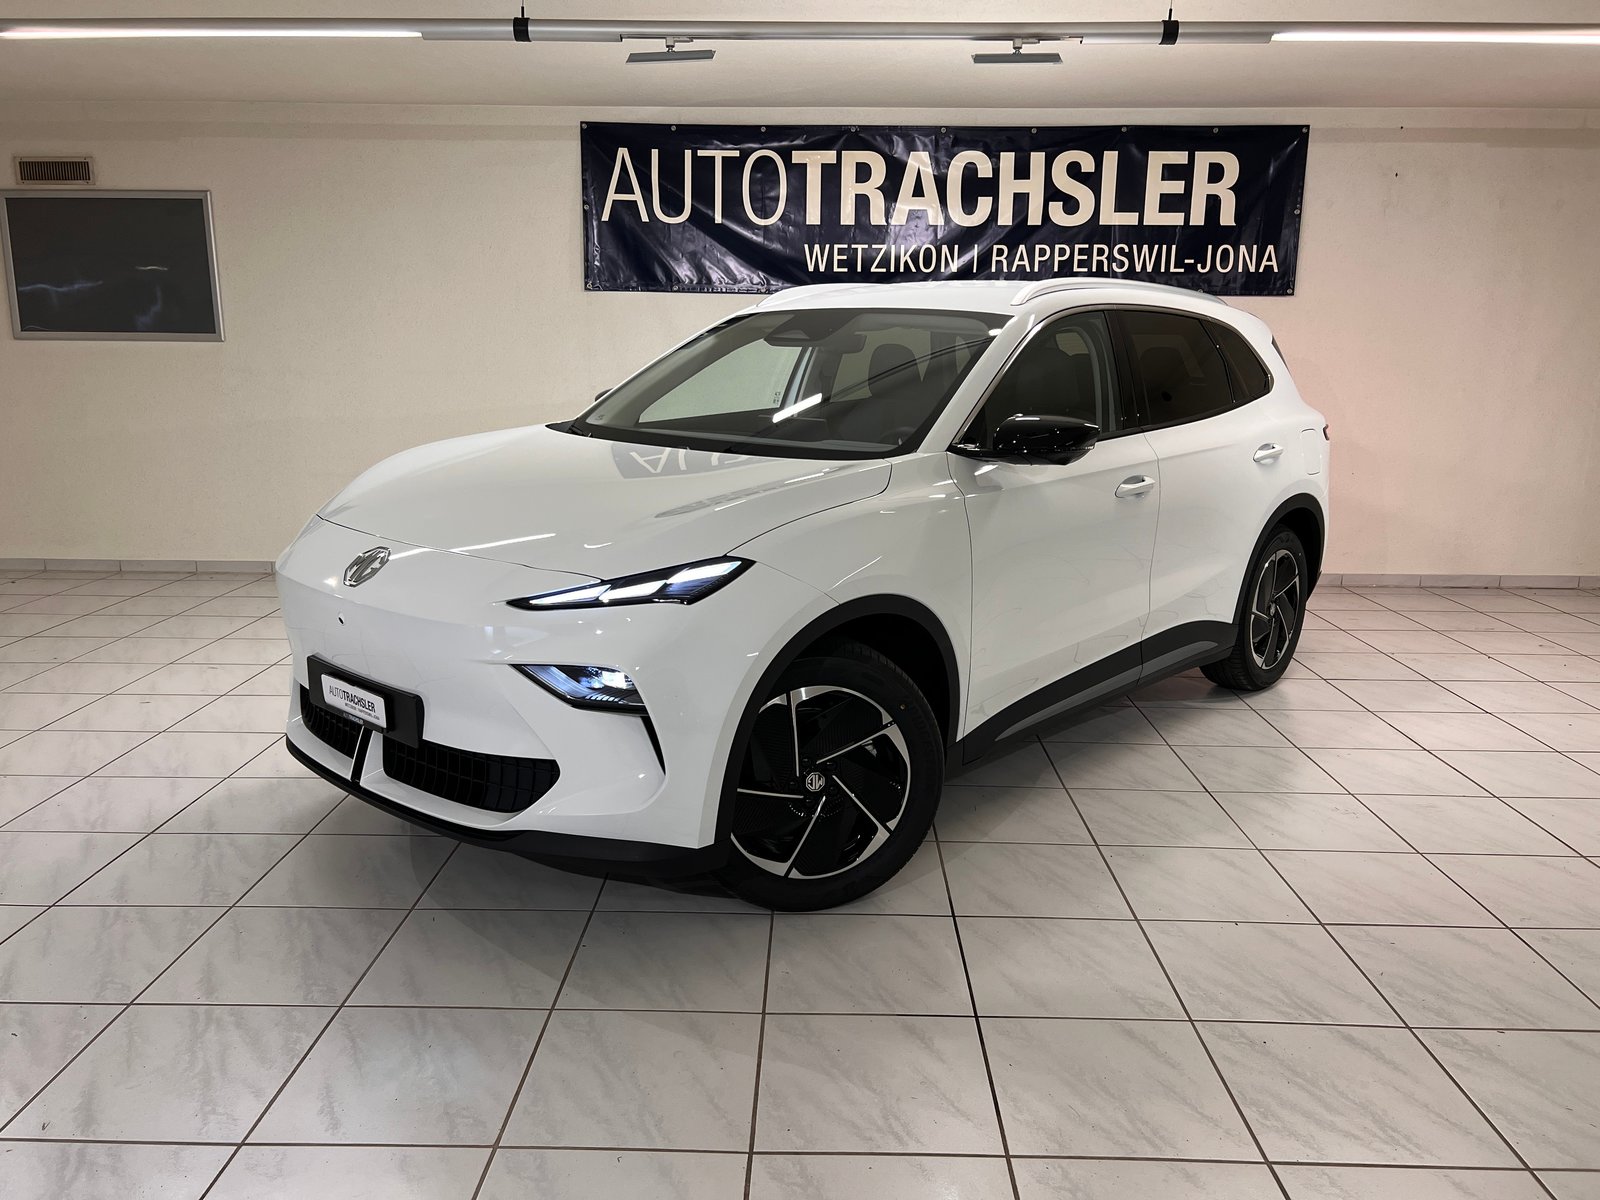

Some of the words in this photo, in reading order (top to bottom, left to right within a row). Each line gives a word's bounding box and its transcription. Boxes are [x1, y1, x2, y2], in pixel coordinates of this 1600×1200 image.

[601, 147, 1240, 226] AUTOTRACHSLER
[804, 243, 959, 273] WETZIKON
[990, 243, 1279, 273] RAPPERSWIL-JONA
